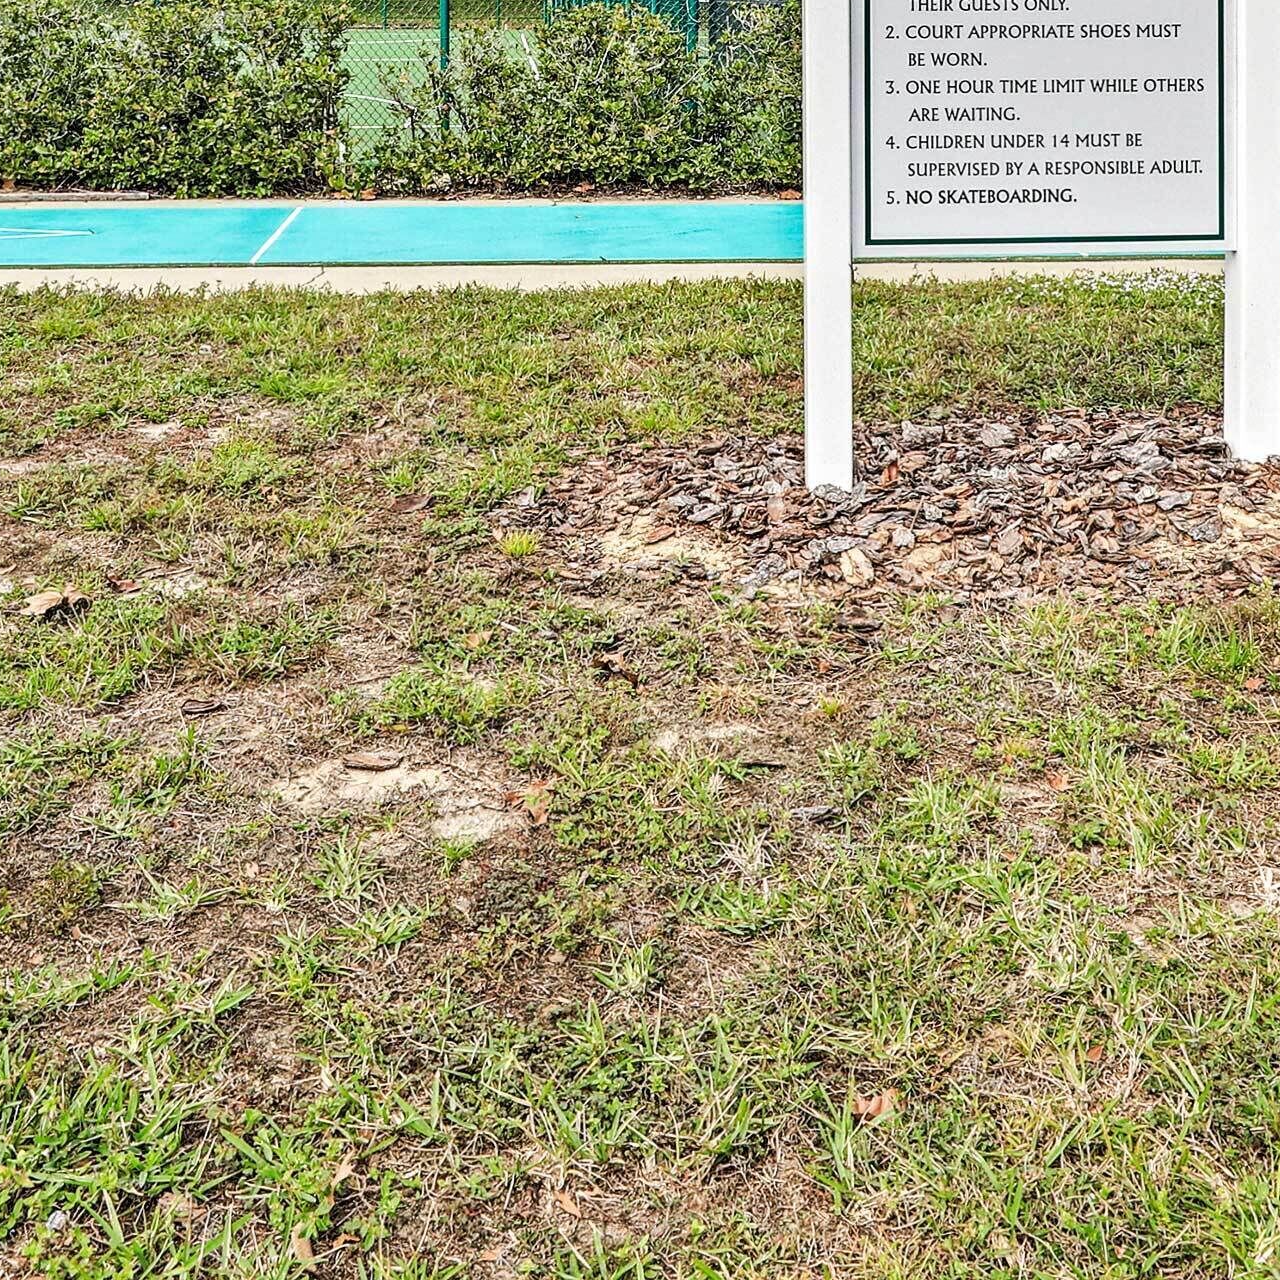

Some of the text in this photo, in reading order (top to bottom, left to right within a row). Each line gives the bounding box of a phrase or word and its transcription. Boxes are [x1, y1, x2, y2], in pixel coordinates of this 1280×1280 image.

[885, 23, 1182, 40] 2. COURT APPROPRIATE SHOES MUST
[908, 52, 988, 67] BE WORN.
[885, 78, 1205, 95] 3. ONE HOUR TIME LIMIT WHILE OTHERS
[908, 106, 1021, 122] ARE WAITING.
[885, 132, 1143, 150] 4. CHILDREN UNDER 14 MUST BE
[907, 159, 1203, 177] SUPERVISED BY A RESPONSIBLE ADULT.
[886, 188, 1078, 205] 5. NO SKATEBOARDING.
